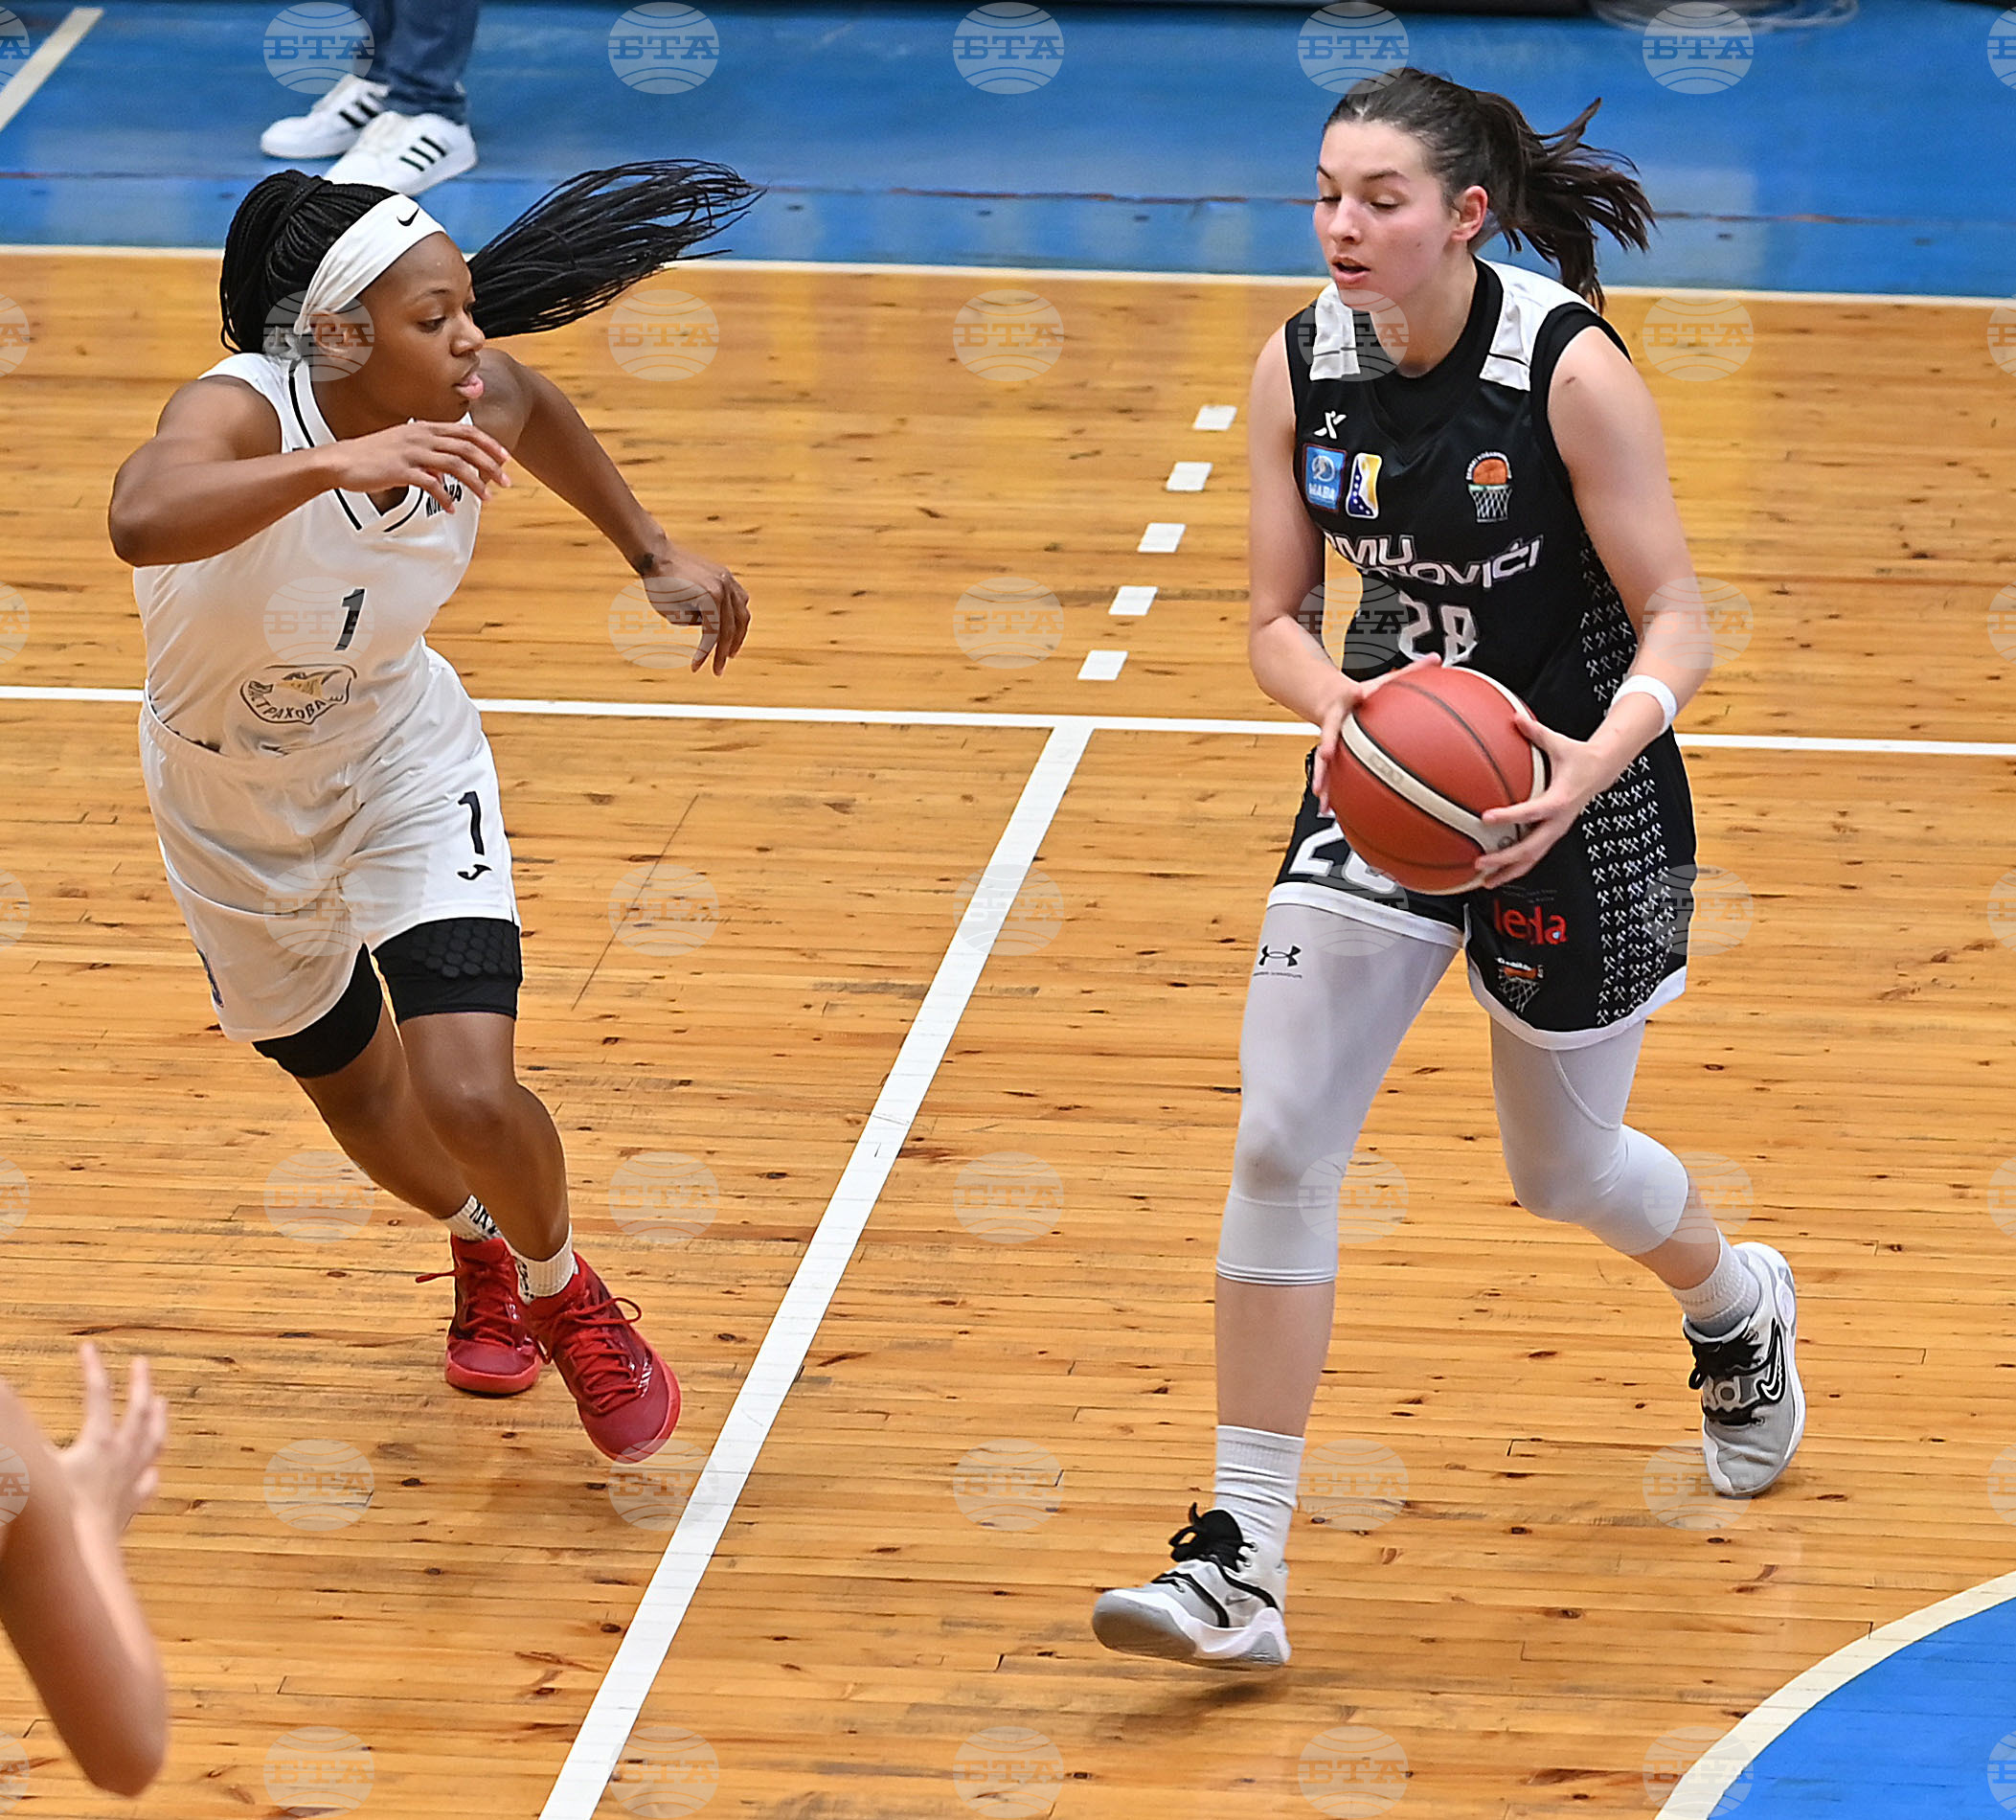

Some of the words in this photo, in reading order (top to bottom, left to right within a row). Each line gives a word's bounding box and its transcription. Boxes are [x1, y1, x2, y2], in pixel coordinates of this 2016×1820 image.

[1325, 532, 1415, 567] MU
[334, 587, 366, 651] 1
[457, 790, 486, 856] 1
